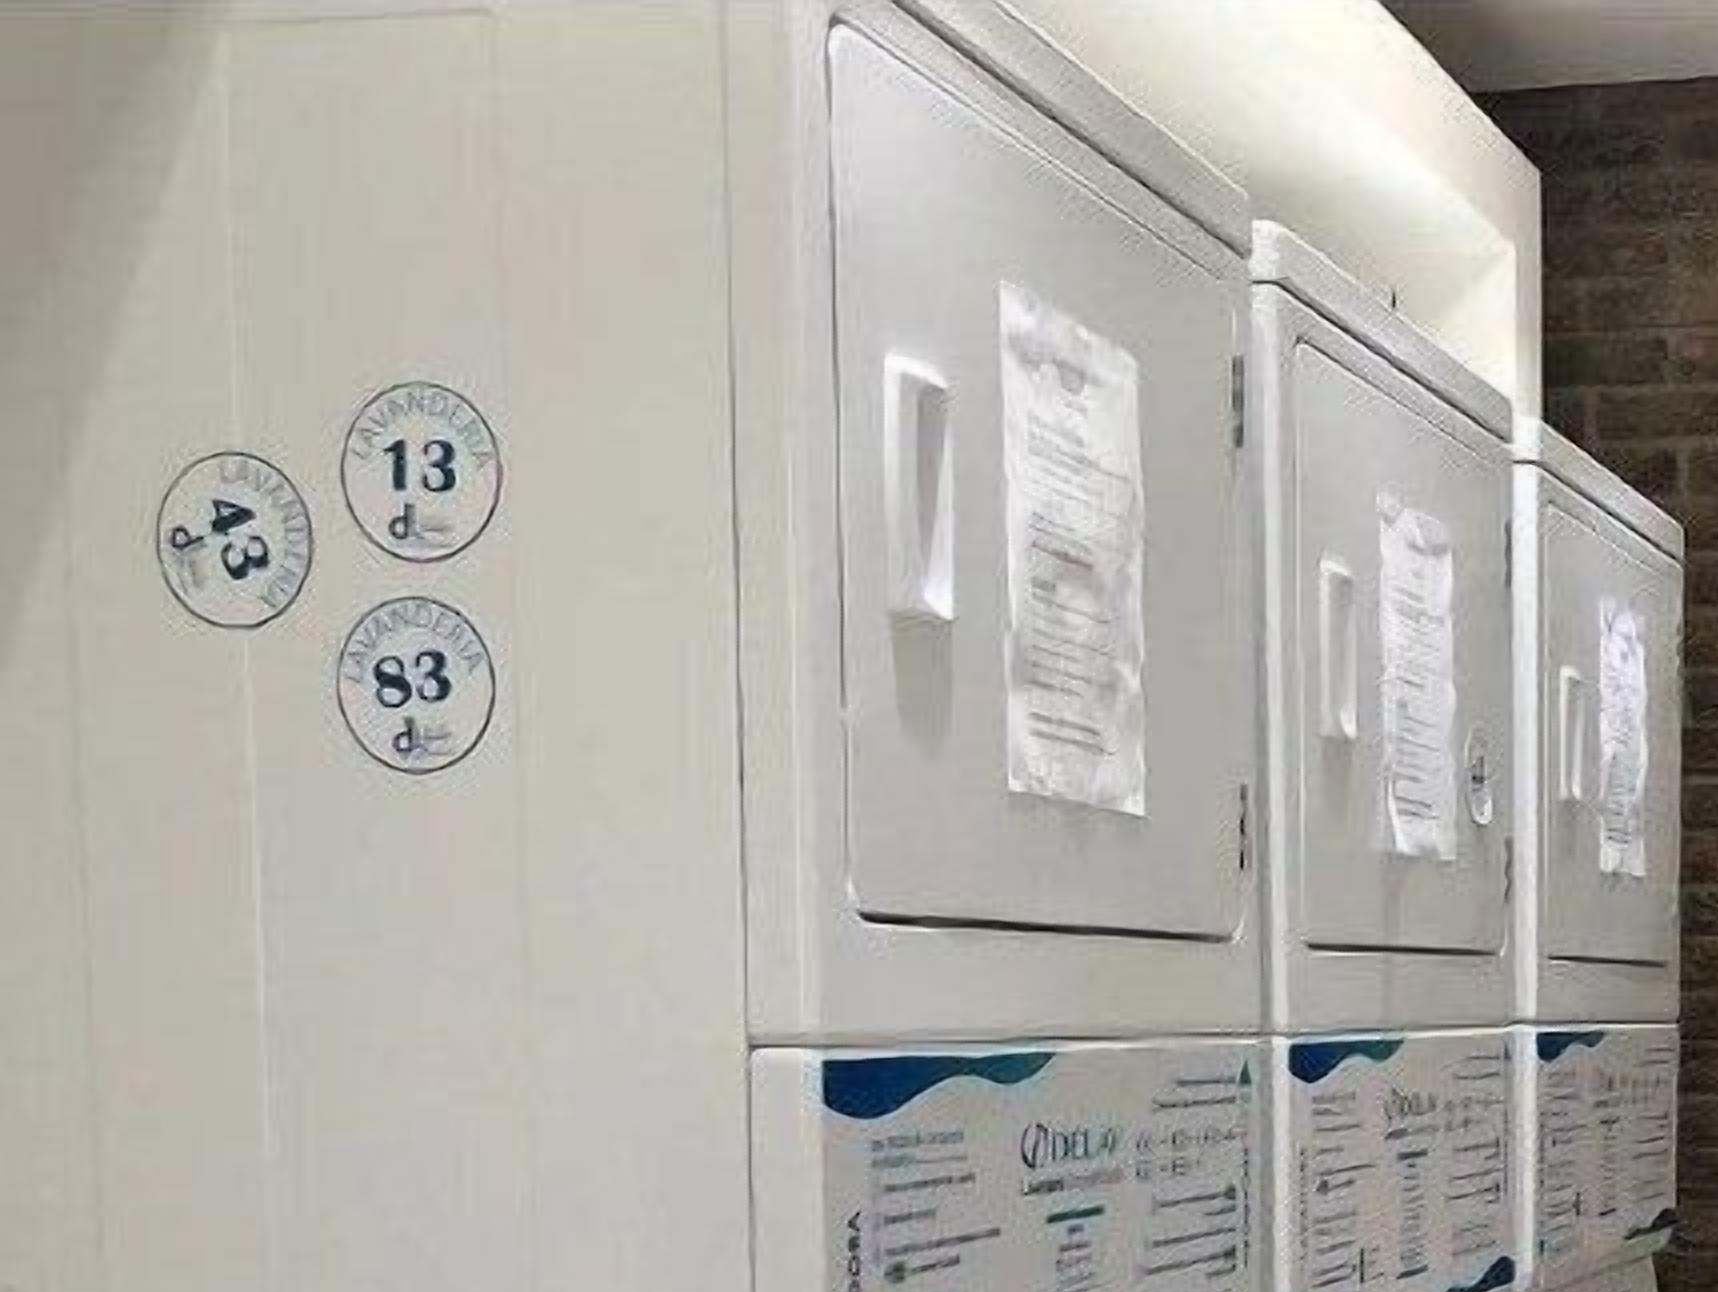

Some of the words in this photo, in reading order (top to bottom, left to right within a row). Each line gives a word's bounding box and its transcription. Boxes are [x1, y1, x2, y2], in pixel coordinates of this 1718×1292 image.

[384, 439, 457, 493] 13
[211, 499, 269, 580] 43
[372, 650, 453, 708] 83
